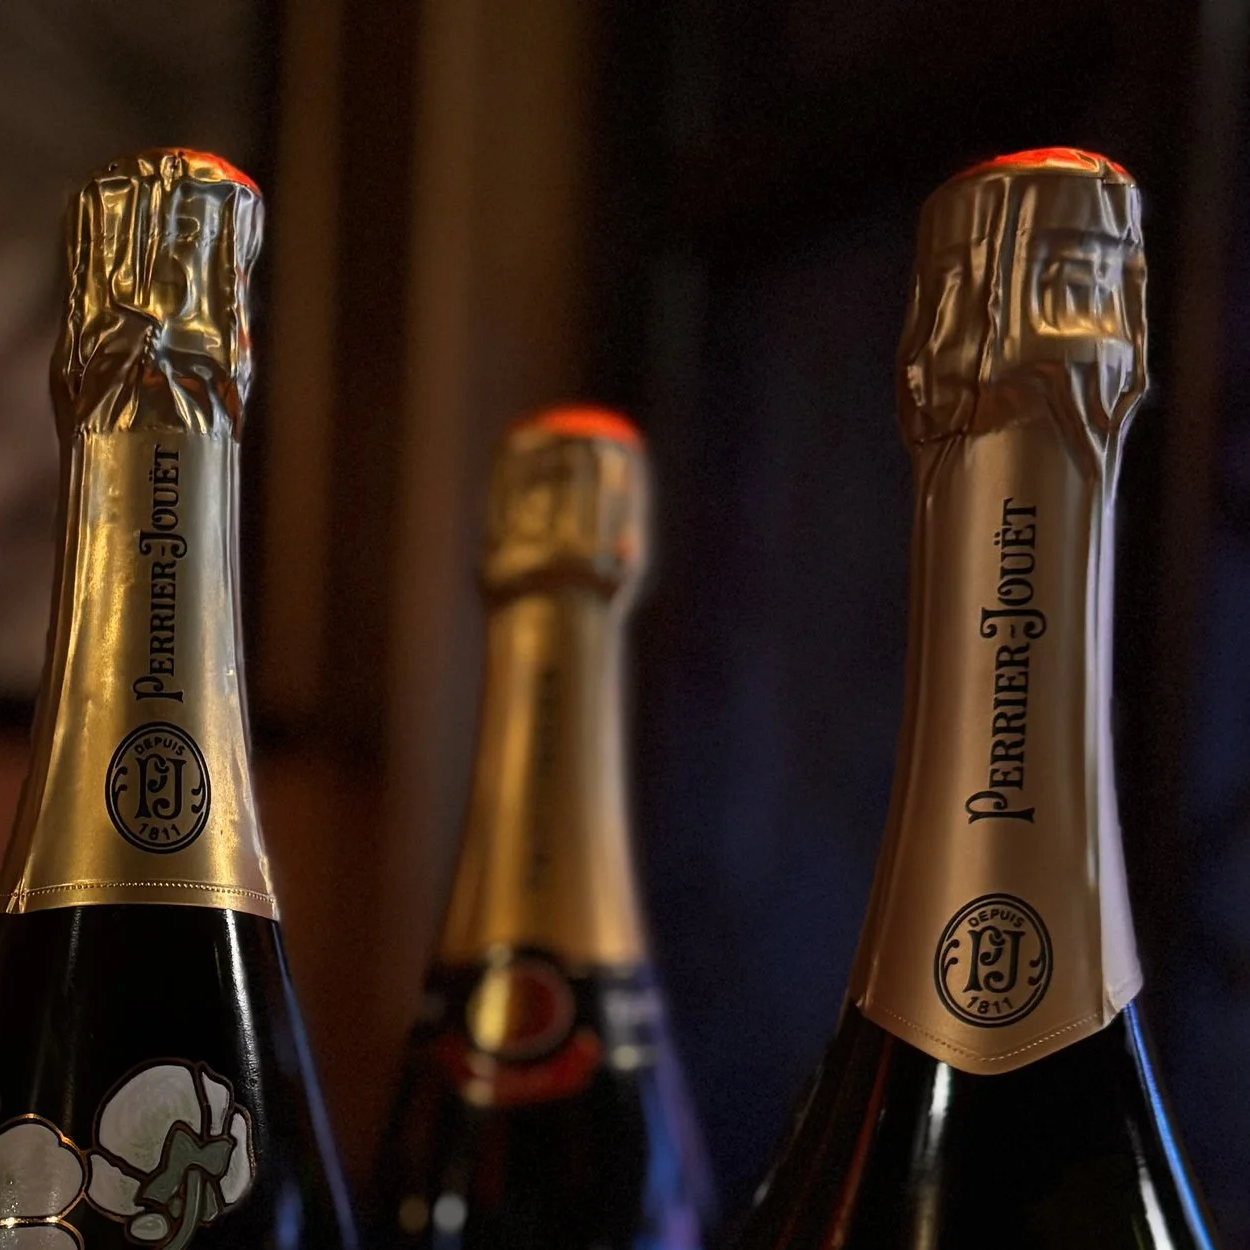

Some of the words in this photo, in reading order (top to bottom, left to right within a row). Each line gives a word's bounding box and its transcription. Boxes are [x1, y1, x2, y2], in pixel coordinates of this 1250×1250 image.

[132, 443, 188, 703] PERRIER-JOUËT
[964, 497, 1047, 825] PERRIER-JOUËT
[135, 737, 185, 756] DEPUIS
[139, 823, 181, 841] 1811
[968, 909, 1025, 928] DEPUIS
[967, 997, 1013, 1014] 1811
